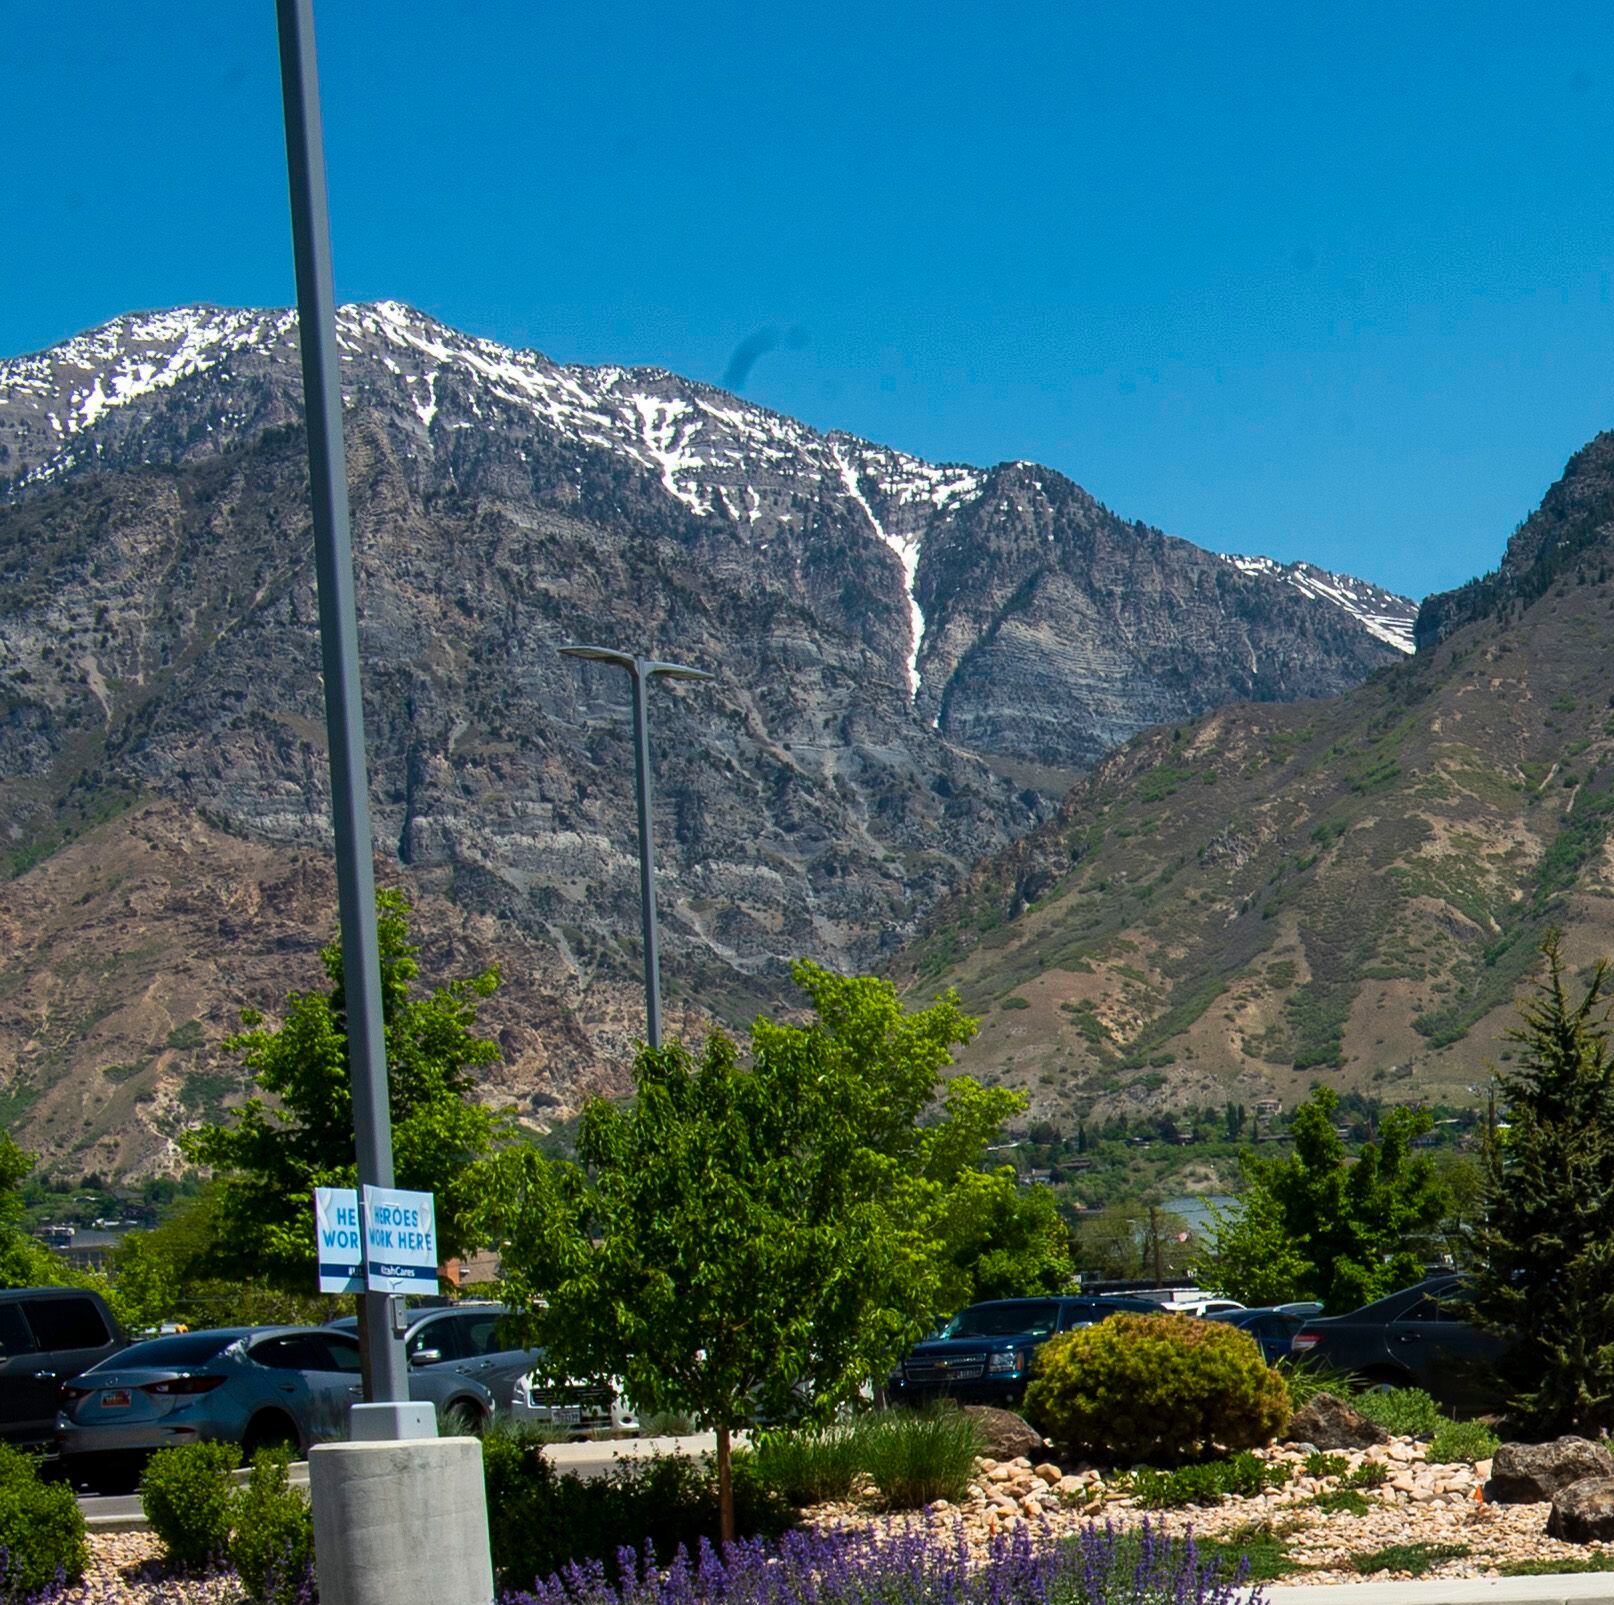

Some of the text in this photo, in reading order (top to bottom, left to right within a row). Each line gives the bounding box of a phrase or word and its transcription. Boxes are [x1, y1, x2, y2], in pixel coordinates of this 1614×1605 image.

[374, 1205, 418, 1228] HEROES
[322, 1229, 358, 1249] WOR
[369, 1227, 432, 1251] WORK HERE
